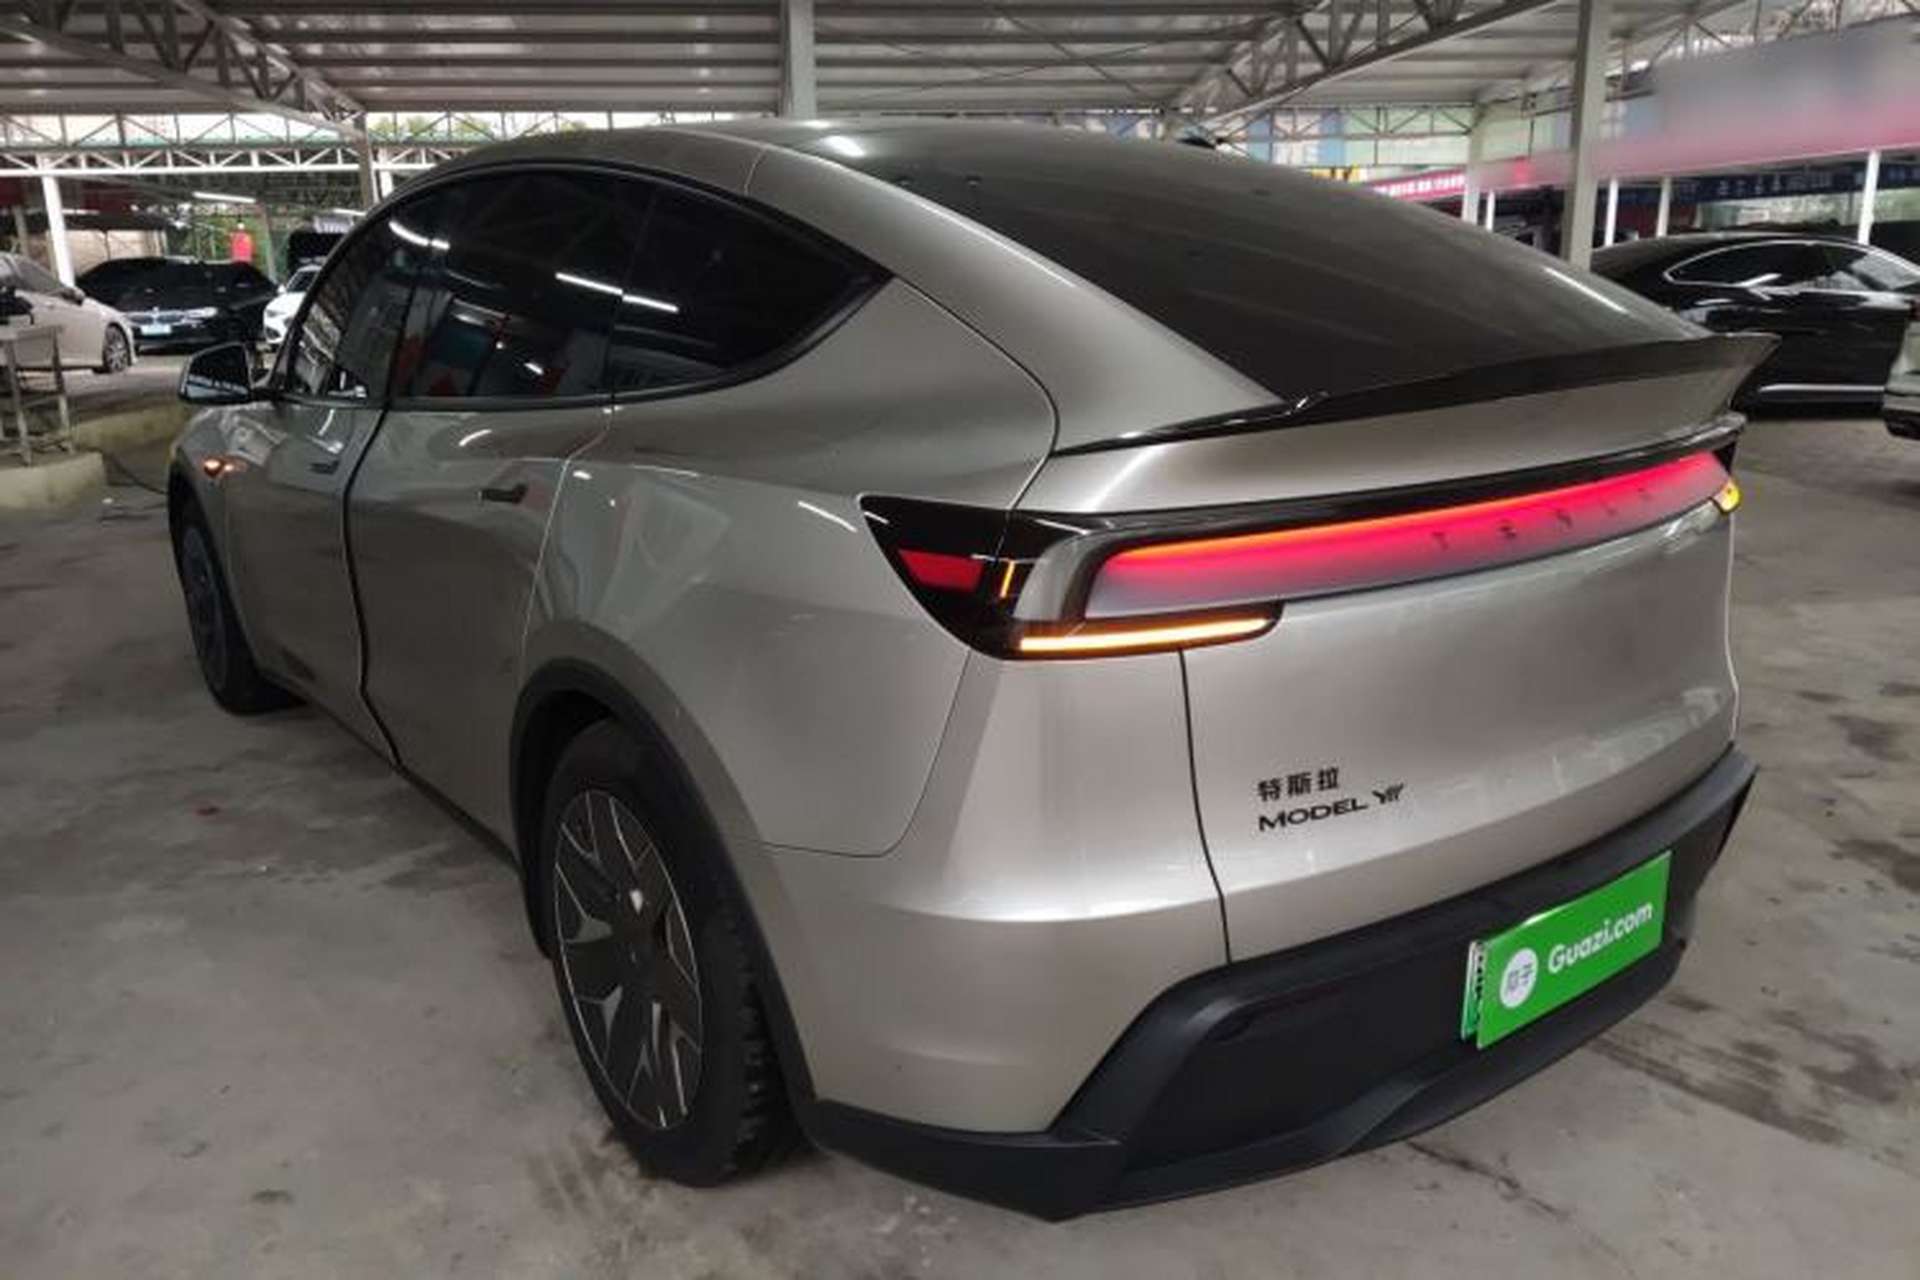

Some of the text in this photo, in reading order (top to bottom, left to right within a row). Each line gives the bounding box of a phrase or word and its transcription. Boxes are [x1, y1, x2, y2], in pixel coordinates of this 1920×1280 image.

[1257, 766, 1339, 802] 特斯拉
[1259, 798, 1368, 831] MODEL
[1548, 902, 1653, 974] Guazi.com
